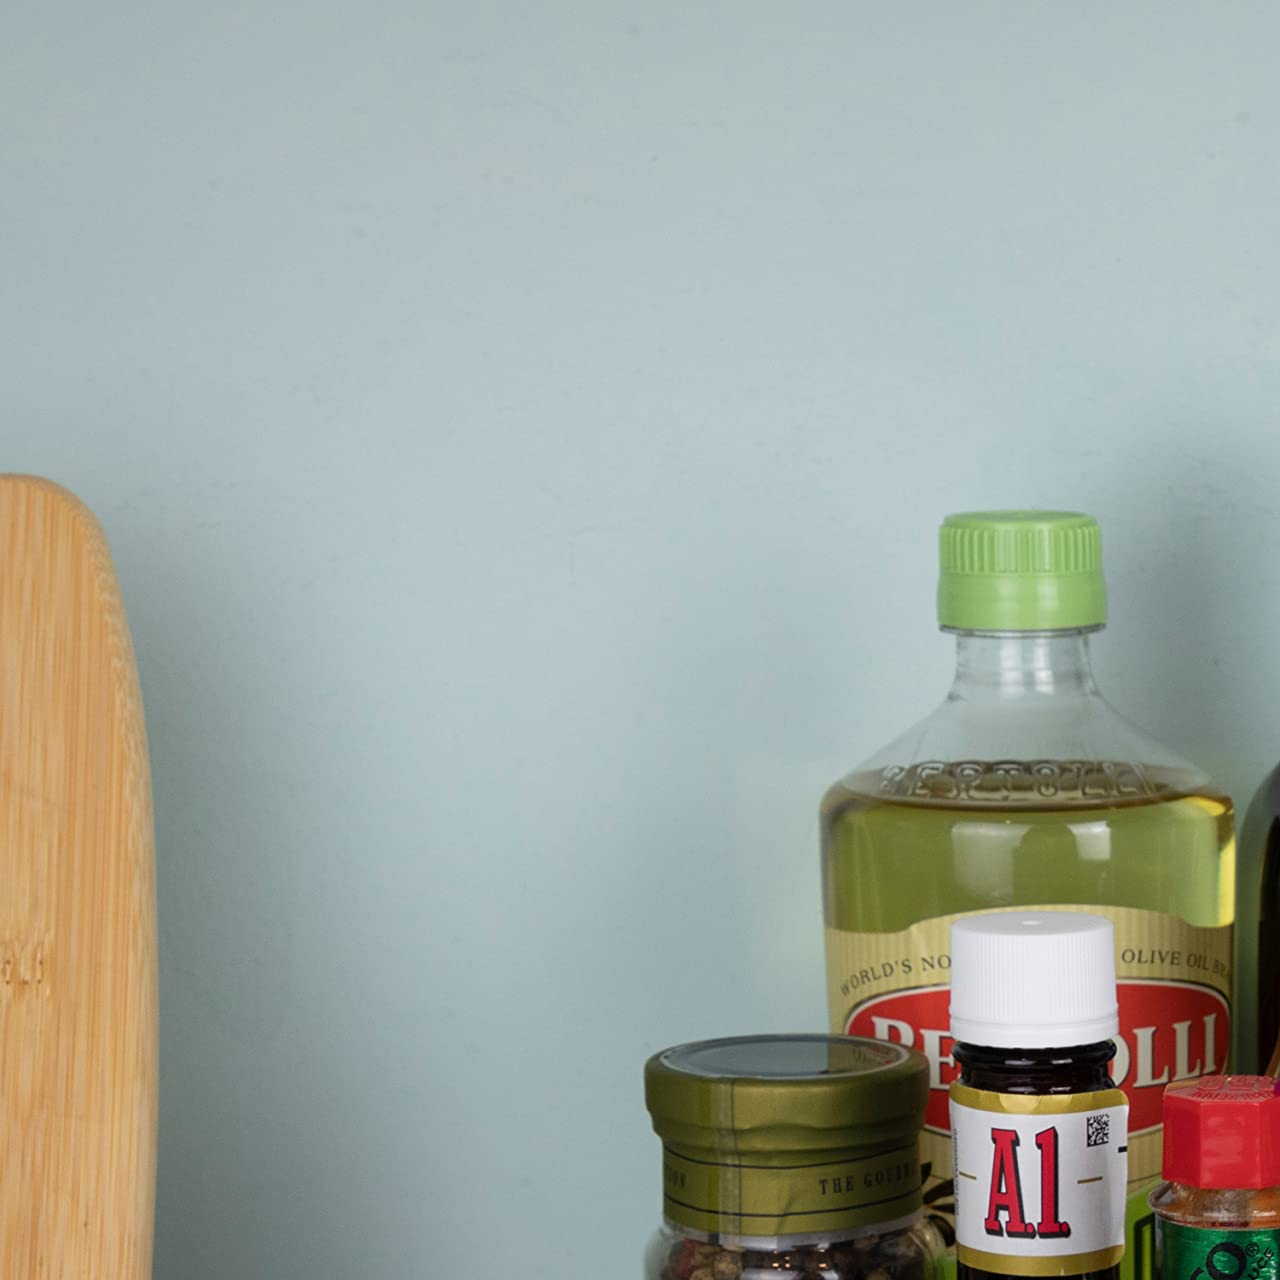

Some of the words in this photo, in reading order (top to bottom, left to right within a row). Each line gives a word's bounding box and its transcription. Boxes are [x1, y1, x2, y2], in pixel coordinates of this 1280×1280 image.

[840, 958, 912, 997] WORLD'S
[1121, 948, 1181, 966] OLIVE
[1186, 953, 1210, 970] OIL
[819, 1178, 854, 1195] THE
